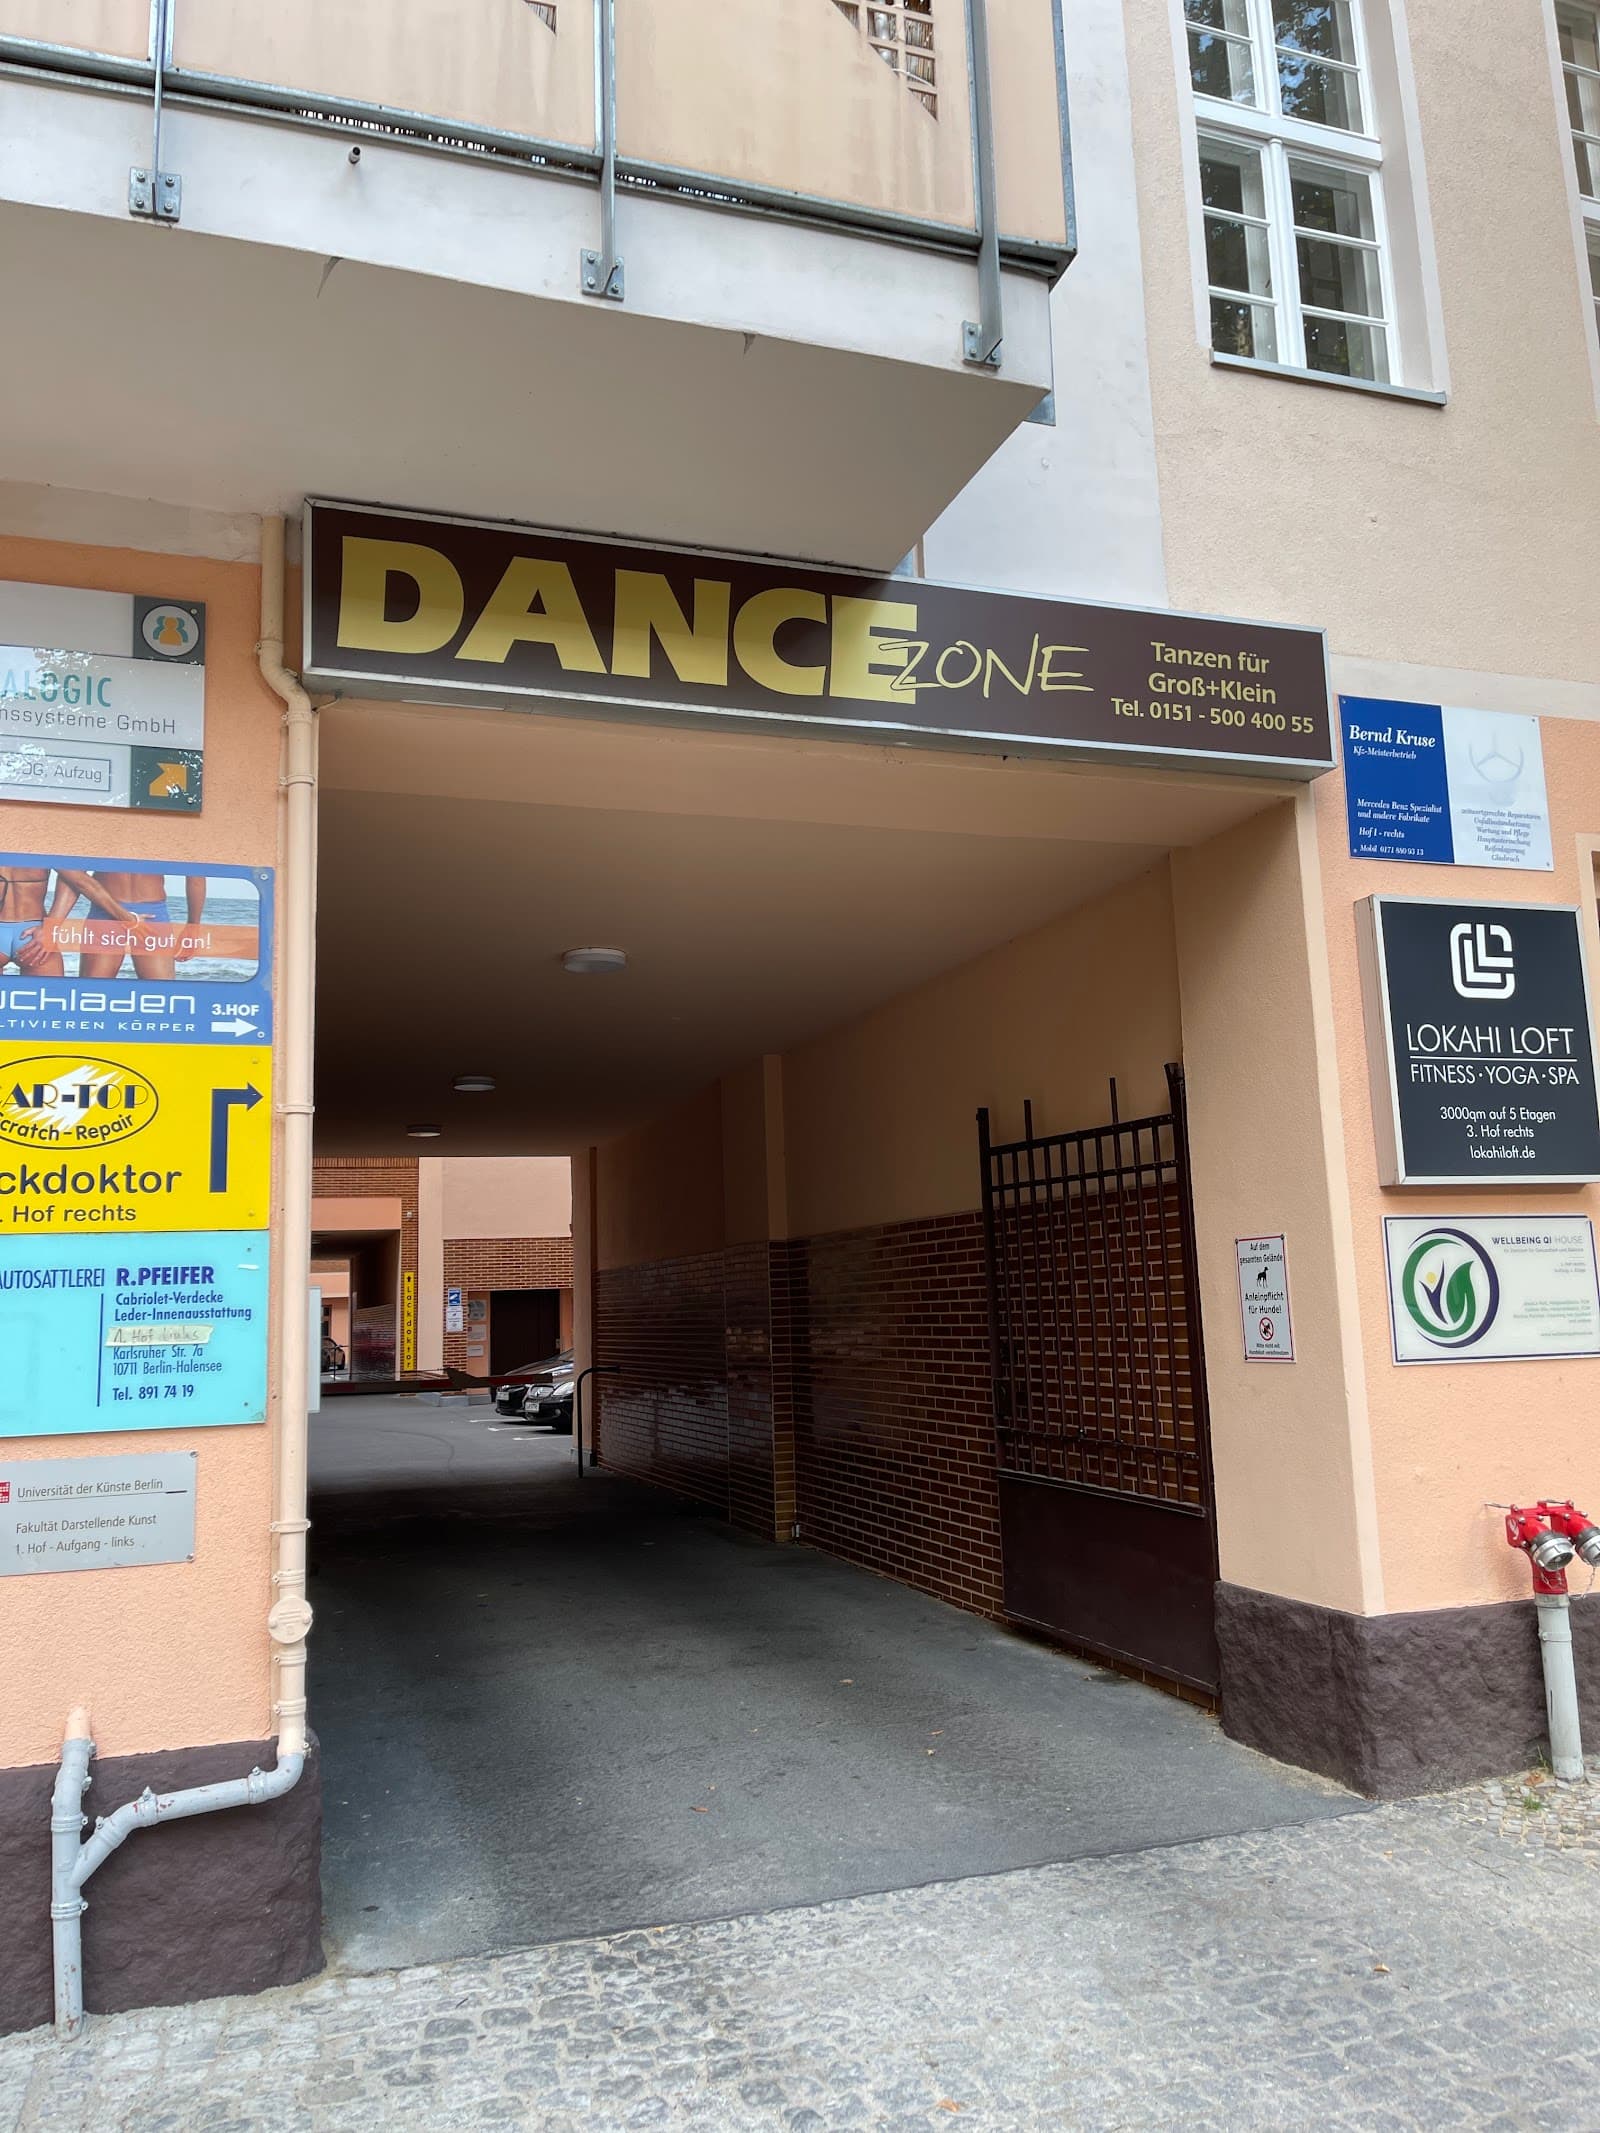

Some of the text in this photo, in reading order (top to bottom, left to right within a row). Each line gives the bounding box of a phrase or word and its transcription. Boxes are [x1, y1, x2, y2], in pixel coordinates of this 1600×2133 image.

[337, 535, 917, 704] DANCE
[1150, 641, 1270, 673] Tanzen für
[879, 633, 1095, 699] ZONE
[1147, 673, 1277, 704] Groß+Klein
[116, 714, 176, 734] GmbH
[1110, 697, 1144, 718] Tel.
[1149, 700, 1192, 722] 0151
[1210, 706, 1246, 728] 500
[1250, 710, 1286, 732] 400
[1291, 715, 1314, 735] 55
[1349, 724, 1436, 748] Bernd Kruse
[1353, 745, 1417, 761] Kfz-Meisterbetrieb
[54, 764, 102, 783] Aufzug
[1357, 798, 1442, 814] Mercedes Benz Spezialist
[1357, 809, 1430, 823] und andere Fabrikate
[1359, 827, 1374, 838] Hof
[1383, 829, 1405, 838] rechts
[52, 927, 212, 951] fühlt sich gut an!
[0, 988, 196, 1014] chladen
[211, 1003, 260, 1017] 3.HOF
[1406, 1023, 1574, 1055] LOKAHI LOFT
[0, 1082, 149, 1110] AR-TOP
[1440, 1107, 1556, 1123] 3000qm auf 5 Etagen
[1466, 1125, 1535, 1138] 3. Hof rechts
[1470, 1146, 1536, 1159] lokahiloft.de
[13, 1205, 137, 1222] Hof rechts
[1492, 1236, 1584, 1245] WELLBEING QI HOUSE
[115, 1266, 215, 1287] R.PFEIFER
[115, 1291, 224, 1306] Cabriolet-Verdecke
[1245, 1291, 1284, 1302] Anleinpflicht
[115, 1307, 252, 1323] Leder-Innenausstattung
[1248, 1305, 1258, 1314] für
[131, 1328, 153, 1343] Hof
[113, 1345, 204, 1360] Karlsruher Str. 7a
[113, 1360, 222, 1376] 10711 Berlin-Halensee
[112, 1385, 194, 1401] Tel. 891 74 19
[17, 1478, 163, 1498] Universität der Künste Berlin
[16, 1515, 157, 1535] Fakultät Darstellende Kunst
[16, 1543, 25, 1555] 1.
[28, 1541, 47, 1554] Hof
[56, 1539, 101, 1554] Aufgang
[111, 1536, 135, 1548] links
